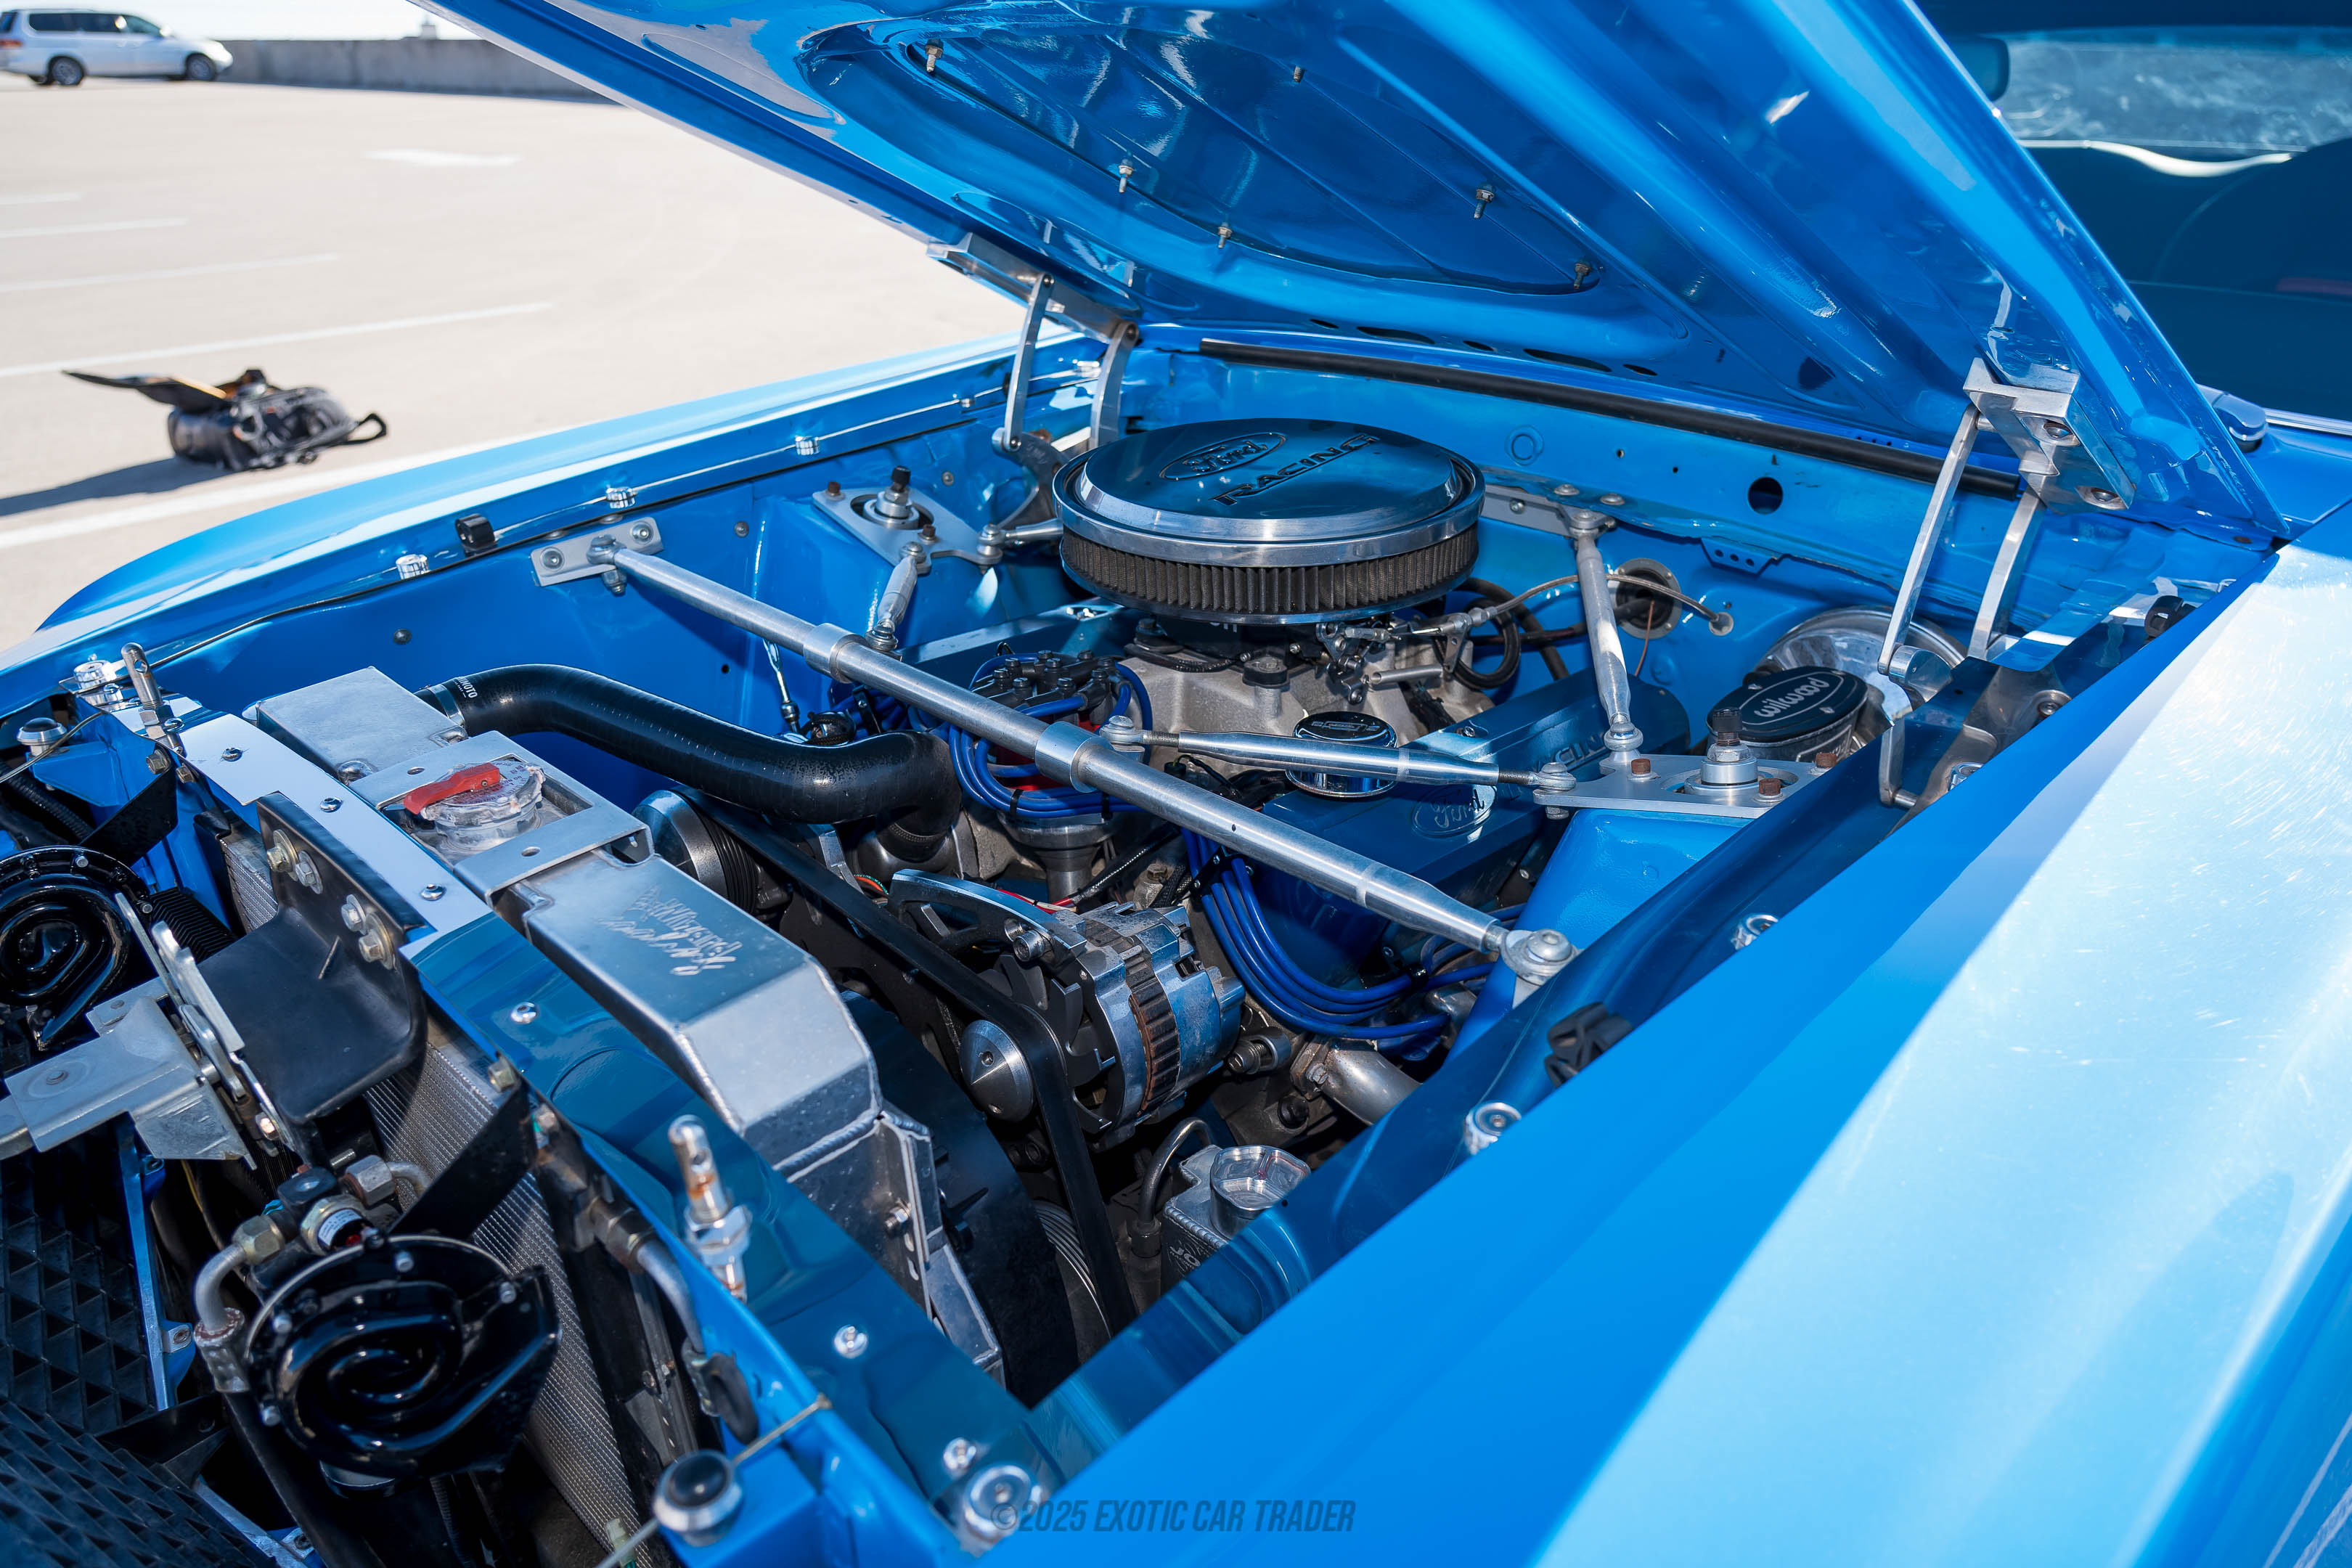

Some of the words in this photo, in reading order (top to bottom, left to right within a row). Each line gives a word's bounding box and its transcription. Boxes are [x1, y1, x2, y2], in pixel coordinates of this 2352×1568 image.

[1183, 440, 1268, 473] Ford
[1208, 433, 1379, 506] RACING
[1753, 677, 1830, 719] wilwood
